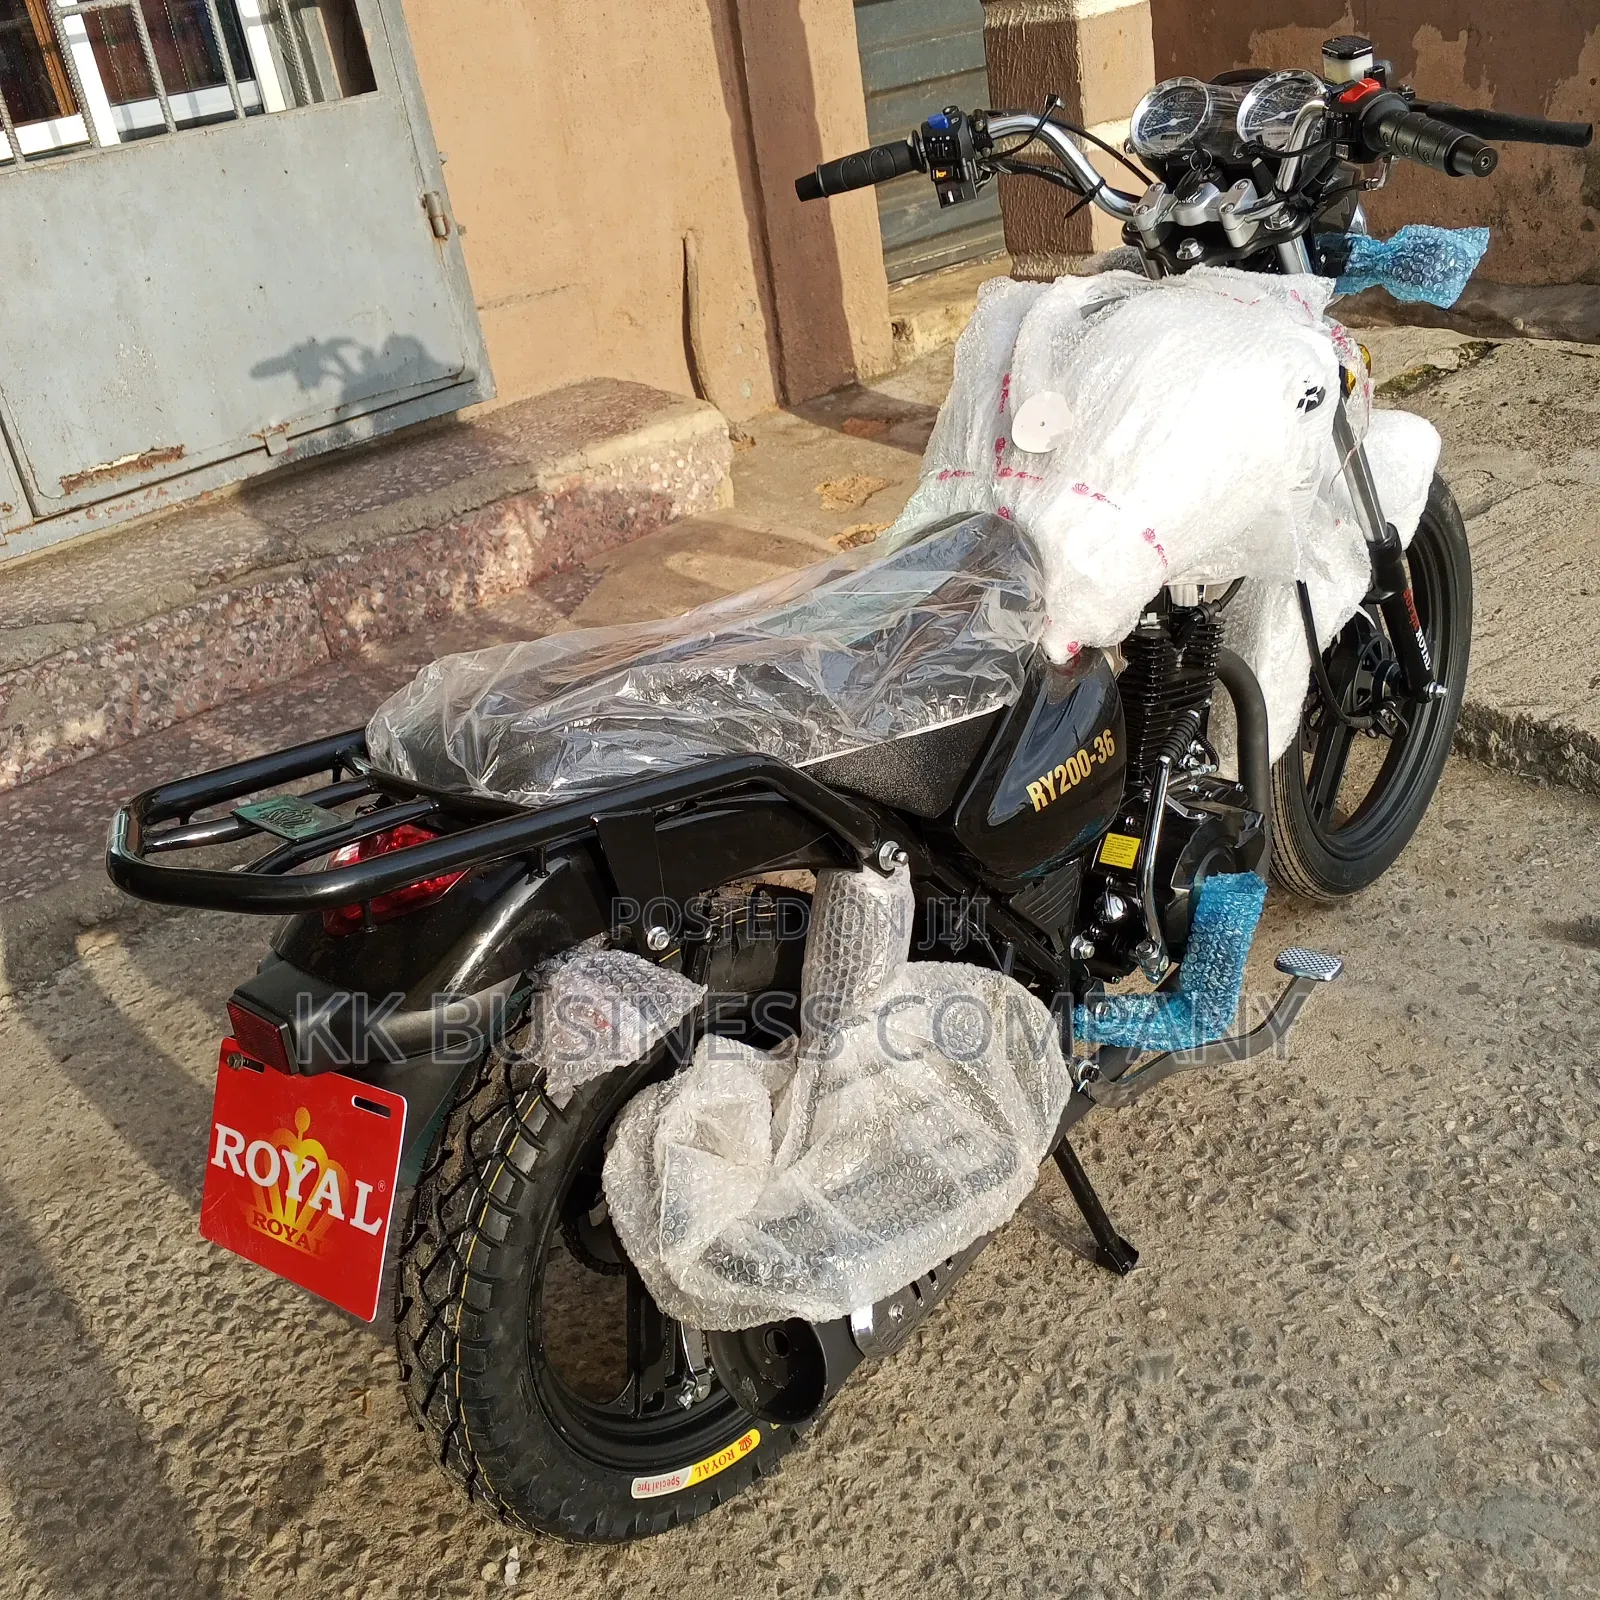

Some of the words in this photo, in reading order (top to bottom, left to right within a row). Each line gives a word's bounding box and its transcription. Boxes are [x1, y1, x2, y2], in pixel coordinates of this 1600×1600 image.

[1026, 728, 1115, 812] RY200-36
[211, 1122, 383, 1236] ROYAL
[251, 1209, 326, 1253] ROYAL
[695, 1449, 735, 1477] ROYAL
[637, 1480, 651, 1492] tyre
[651, 1476, 681, 1492] Special
